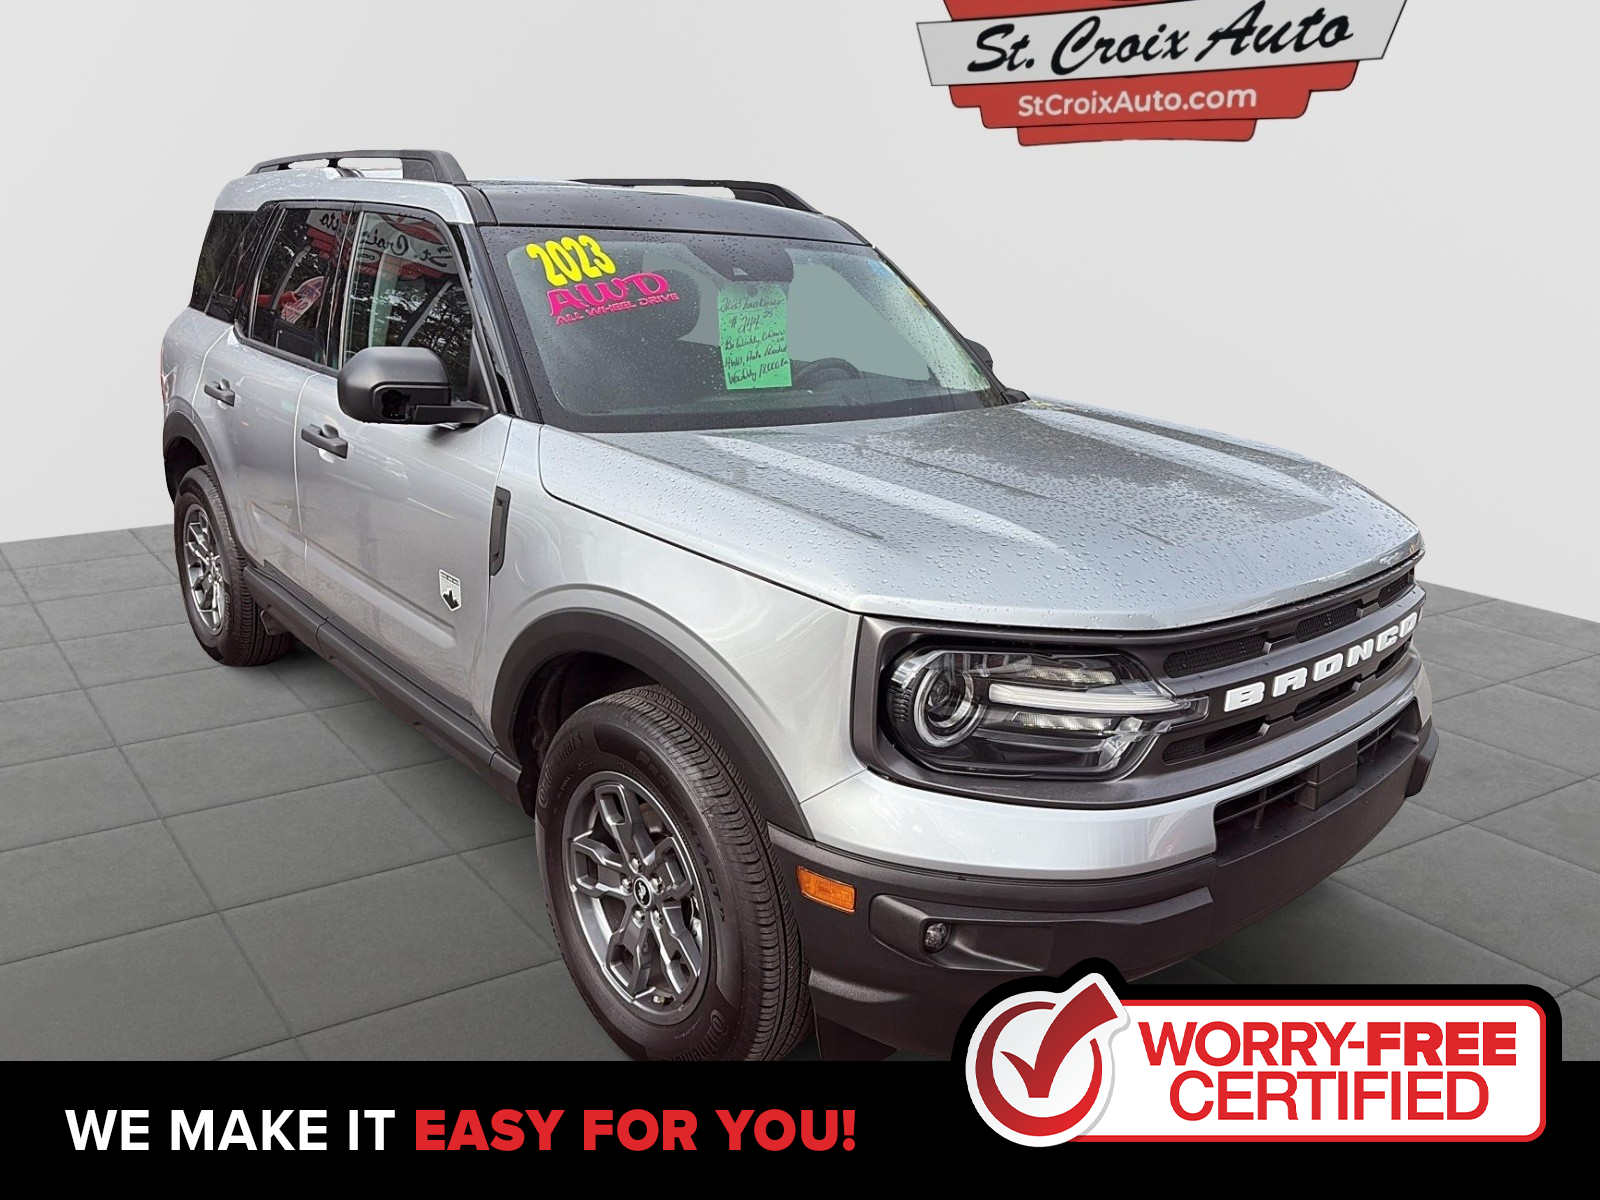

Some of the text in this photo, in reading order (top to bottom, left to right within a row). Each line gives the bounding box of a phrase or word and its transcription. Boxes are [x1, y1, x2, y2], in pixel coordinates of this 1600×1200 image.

[967, 0, 1354, 76] St. Croix Auto
[1017, 86, 1258, 118] StCroixAuto.com
[526, 235, 616, 287] 2023
[547, 272, 670, 316] AWD
[556, 292, 680, 327] ALL WHEEL DRIVE
[1223, 611, 1419, 713] BRONCO
